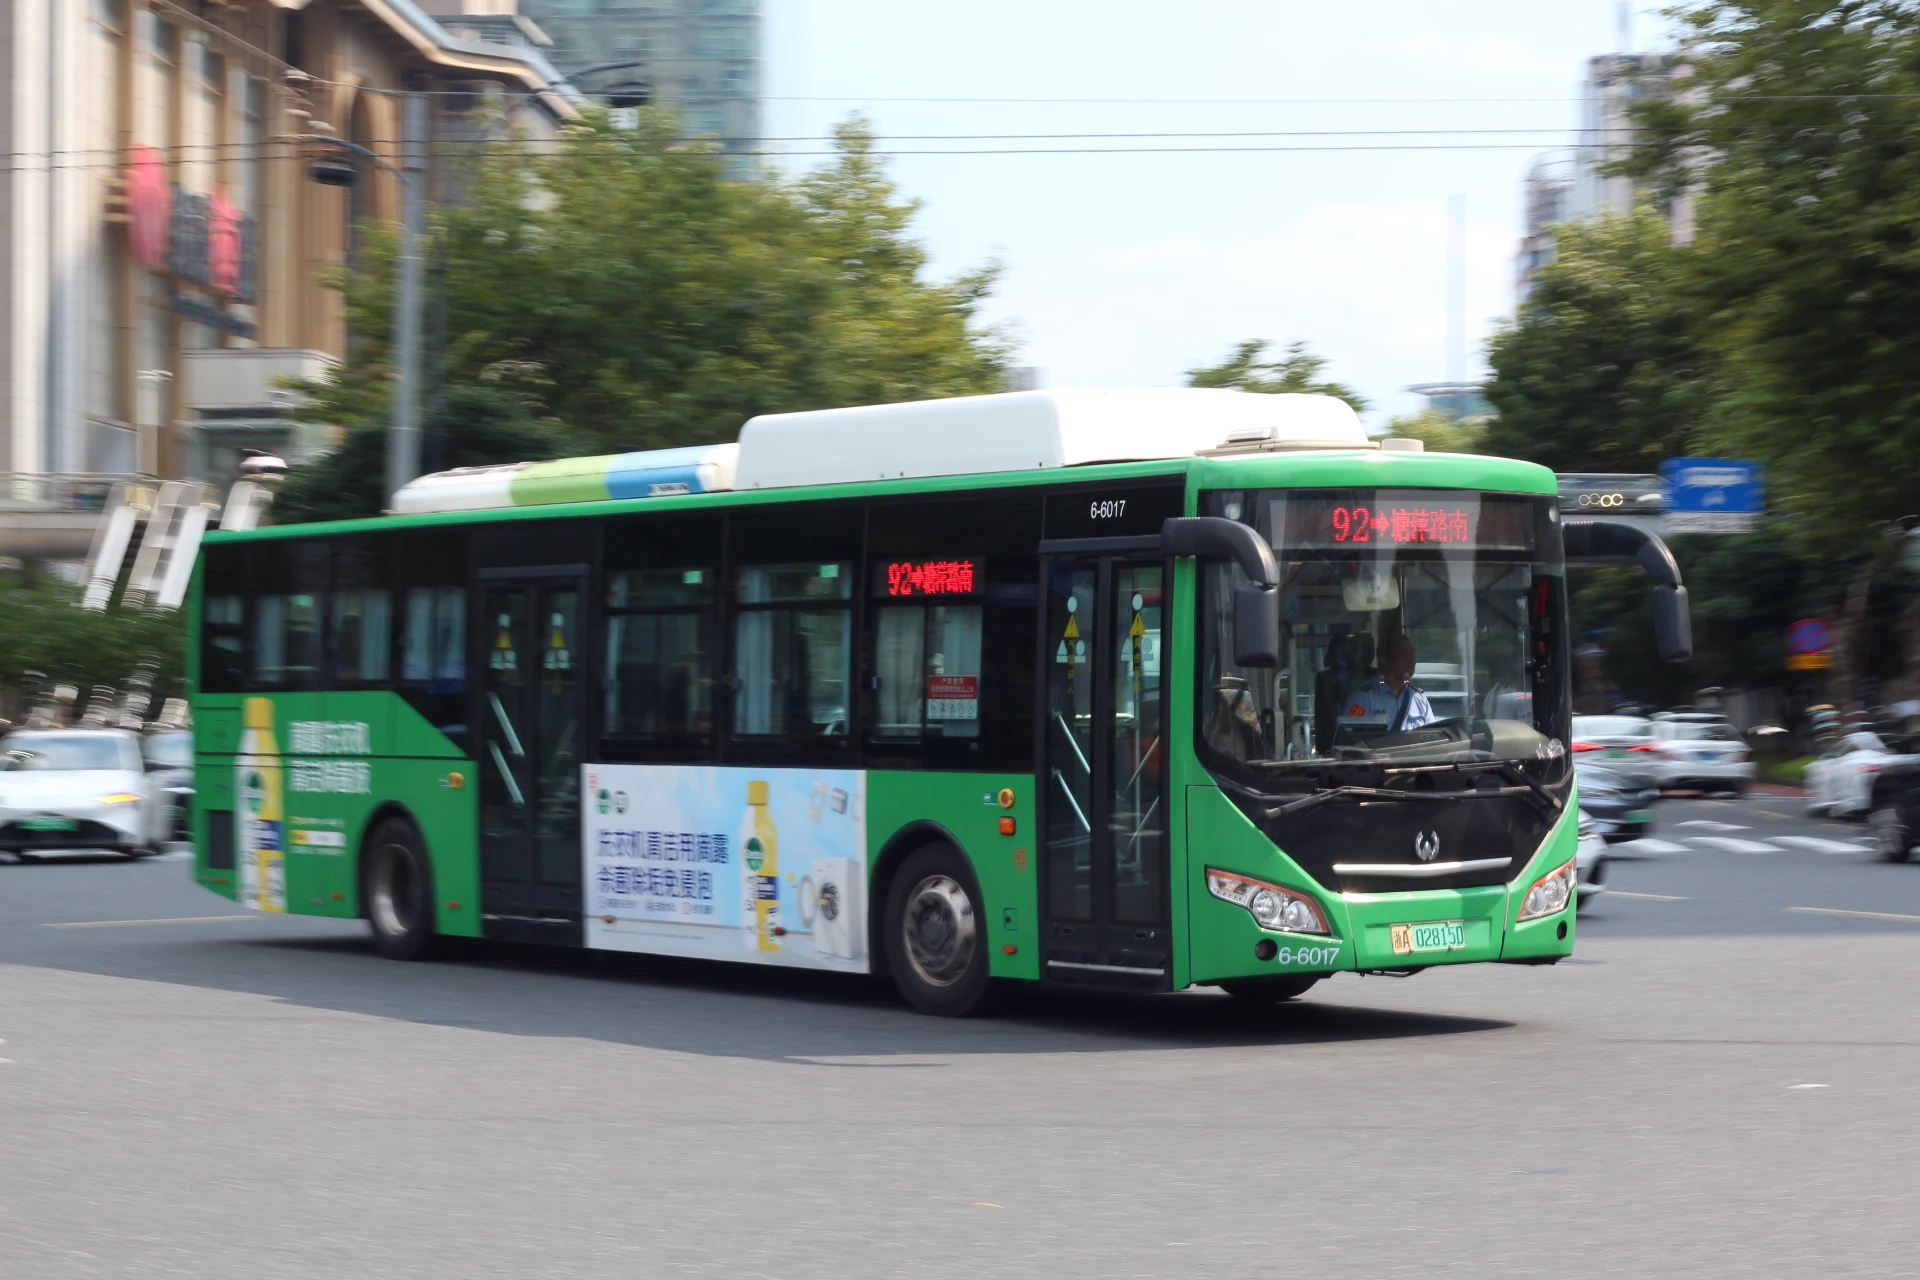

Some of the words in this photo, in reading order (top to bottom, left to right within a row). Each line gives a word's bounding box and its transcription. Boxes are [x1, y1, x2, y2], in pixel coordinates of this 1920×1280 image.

[1090, 499, 1126, 519] 6-6017
[1332, 507, 1370, 542] 92
[888, 563, 913, 596] 92
[1278, 947, 1340, 966] 6-6017
